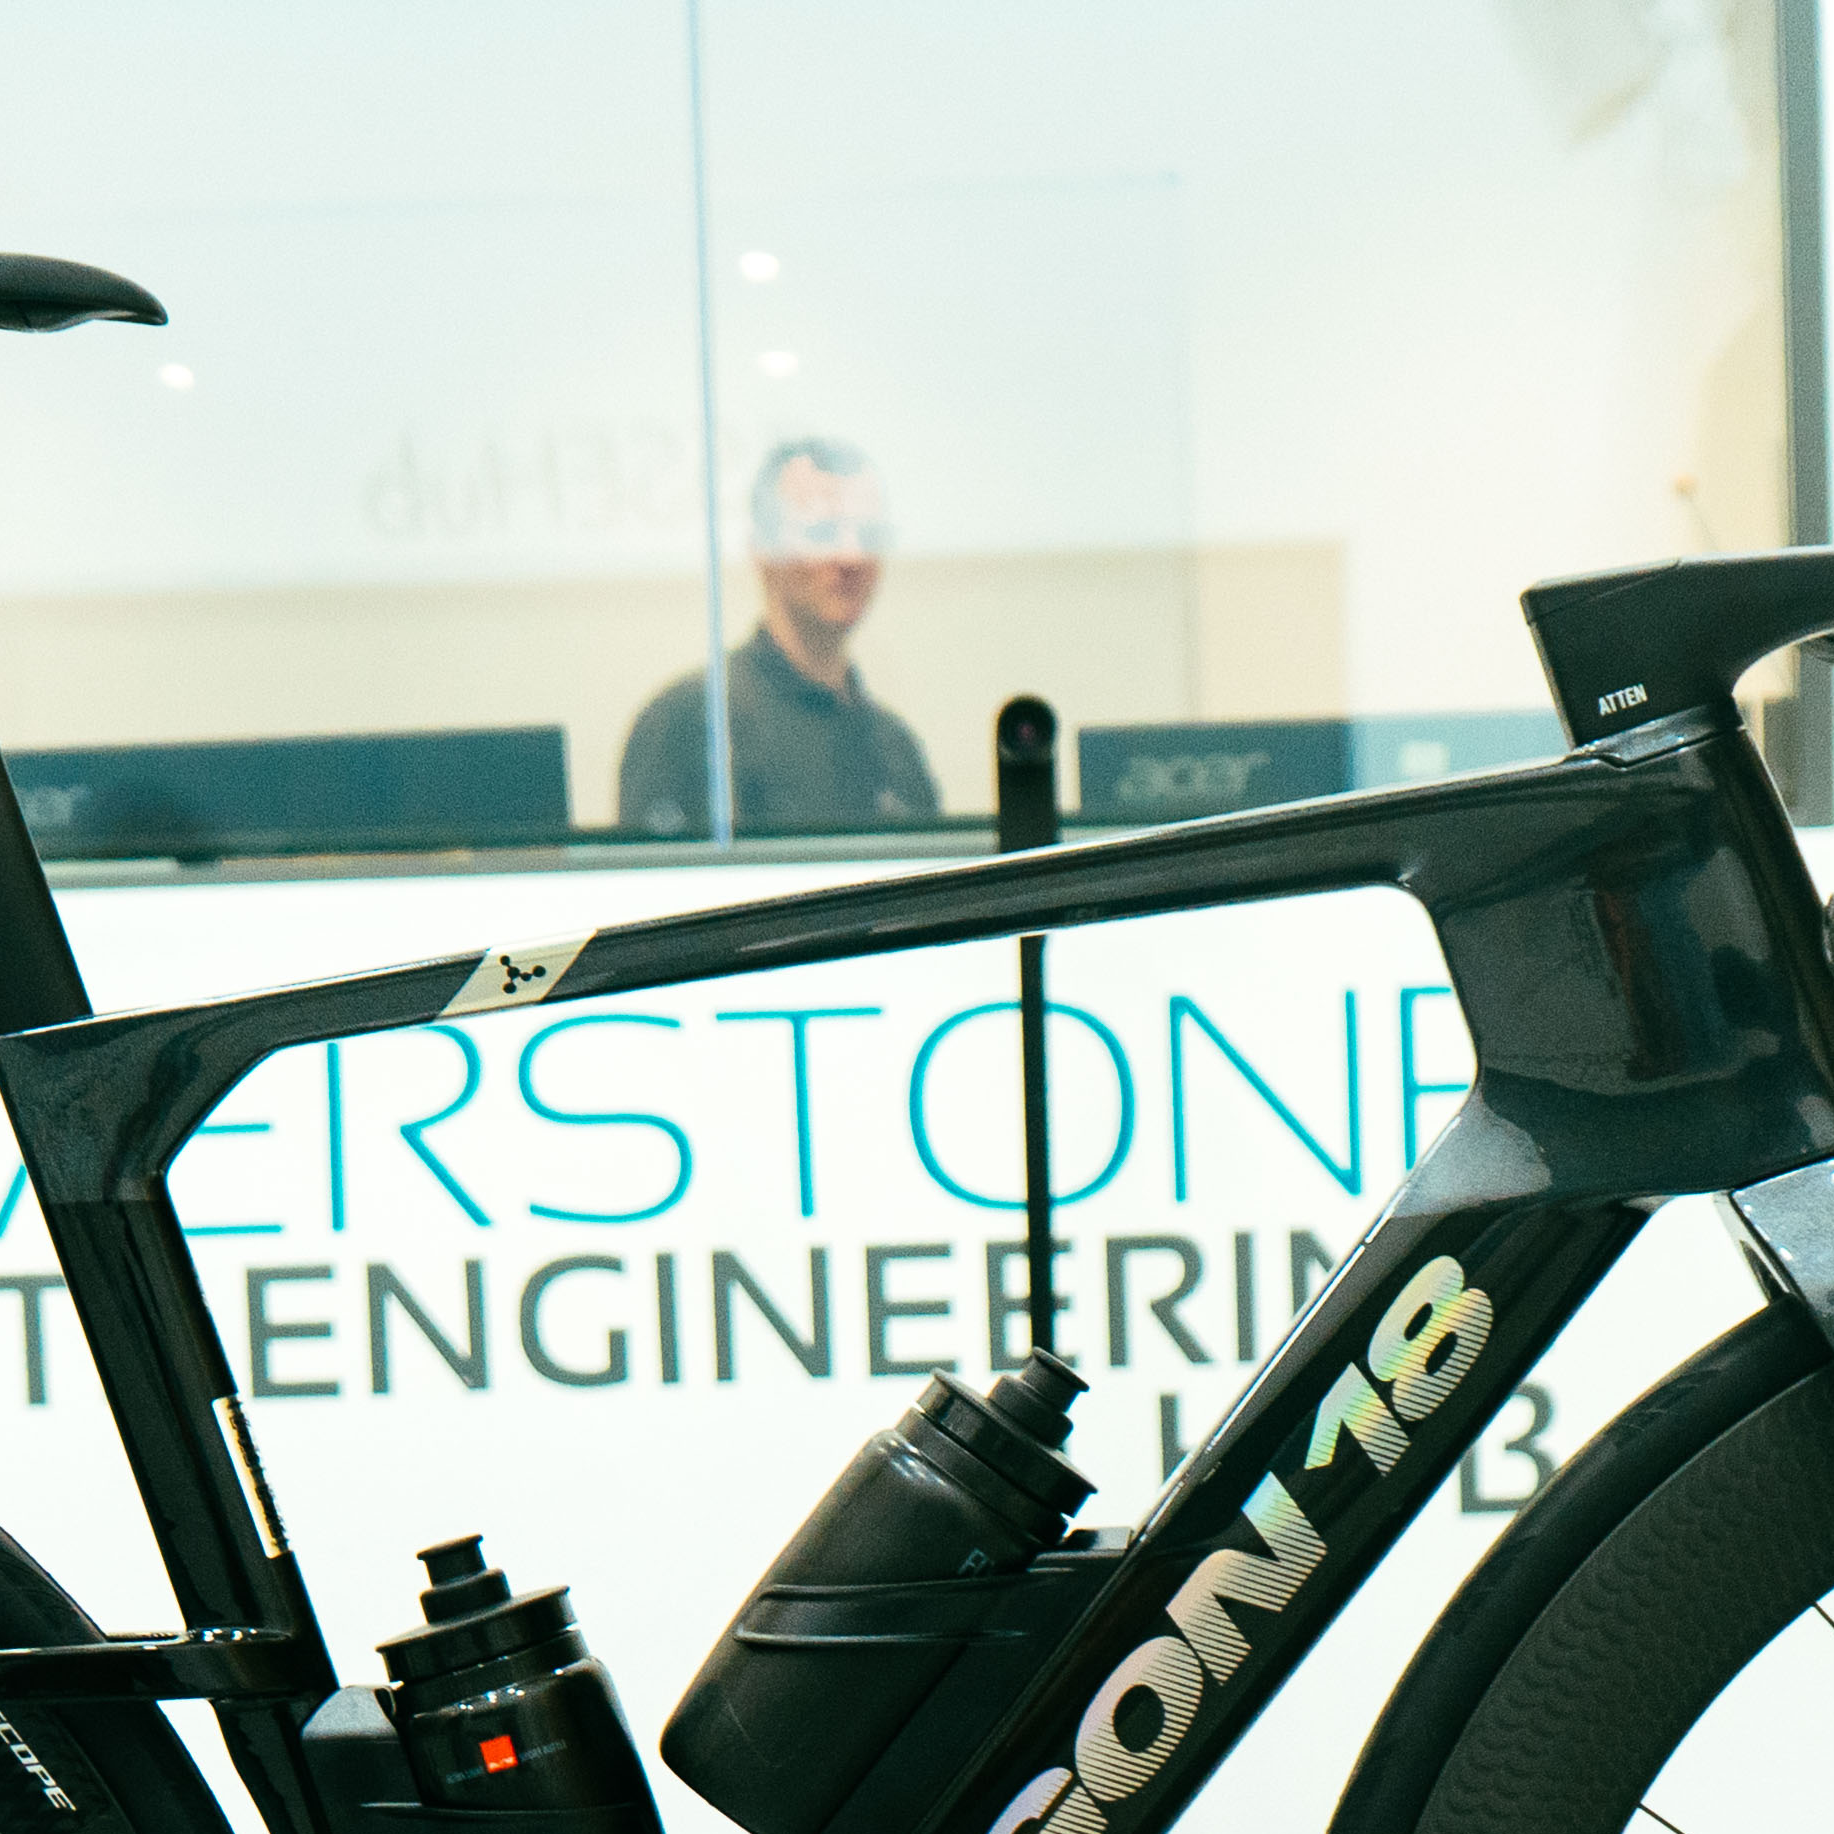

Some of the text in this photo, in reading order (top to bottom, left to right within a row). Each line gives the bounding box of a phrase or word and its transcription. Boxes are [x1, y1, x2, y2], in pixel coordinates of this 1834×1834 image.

[1597, 683, 1649, 718] ATTEN
[1117, 752, 1272, 800] acer
[1304, 1255, 1494, 1478] 18
